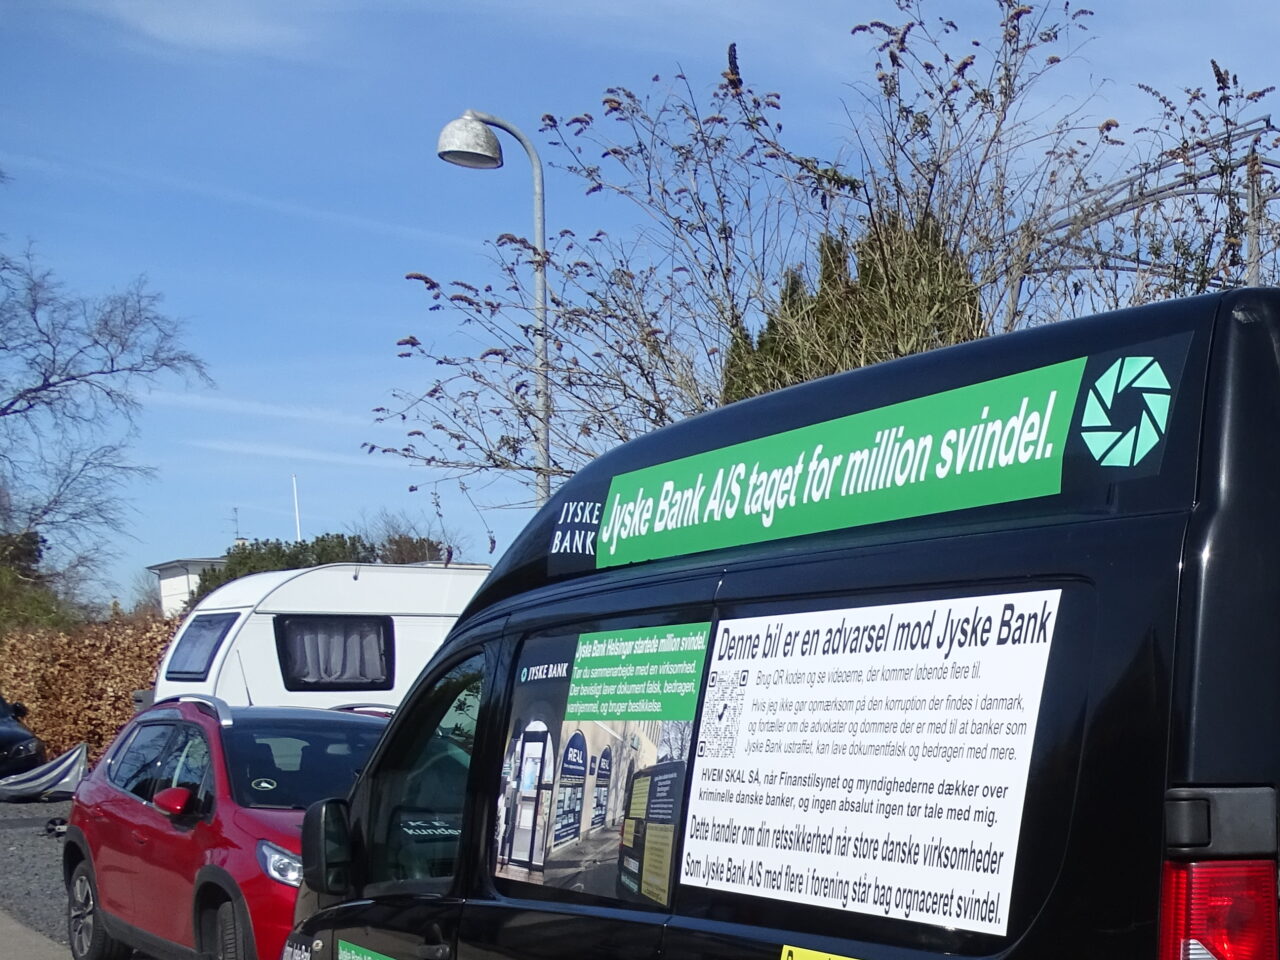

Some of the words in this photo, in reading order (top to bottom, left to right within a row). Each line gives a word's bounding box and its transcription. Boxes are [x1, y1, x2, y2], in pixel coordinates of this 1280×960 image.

[601, 487, 653, 554] Jyske
[653, 472, 706, 532] Bank
[702, 462, 745, 522] A/S
[743, 451, 804, 527] taget
[802, 444, 843, 503] for
[840, 425, 933, 496] million
[935, 390, 1056, 478] svindel.
[558, 500, 601, 525] JYSKE
[551, 530, 595, 555] BANK
[717, 627, 759, 660] Denne
[761, 622, 783, 658] bil
[782, 630, 800, 657] er
[800, 628, 819, 656] en
[822, 613, 893, 655] advarsel
[892, 609, 936, 650] mod
[936, 605, 992, 659] Jyske
[996, 600, 1051, 645] Bank
[527, 665, 547, 681] JYSKE
[547, 663, 569, 678] BANK
[701, 768, 723, 781] HVEM
[724, 768, 745, 783] SKAL
[747, 769, 760, 786] SÅ,
[763, 769, 777, 784] når
[778, 771, 840, 791] Finanstilsynet
[841, 777, 854, 793] og
[855, 776, 934, 795] myndighederne
[937, 779, 979, 796] dækker
[981, 785, 1008, 798] over
